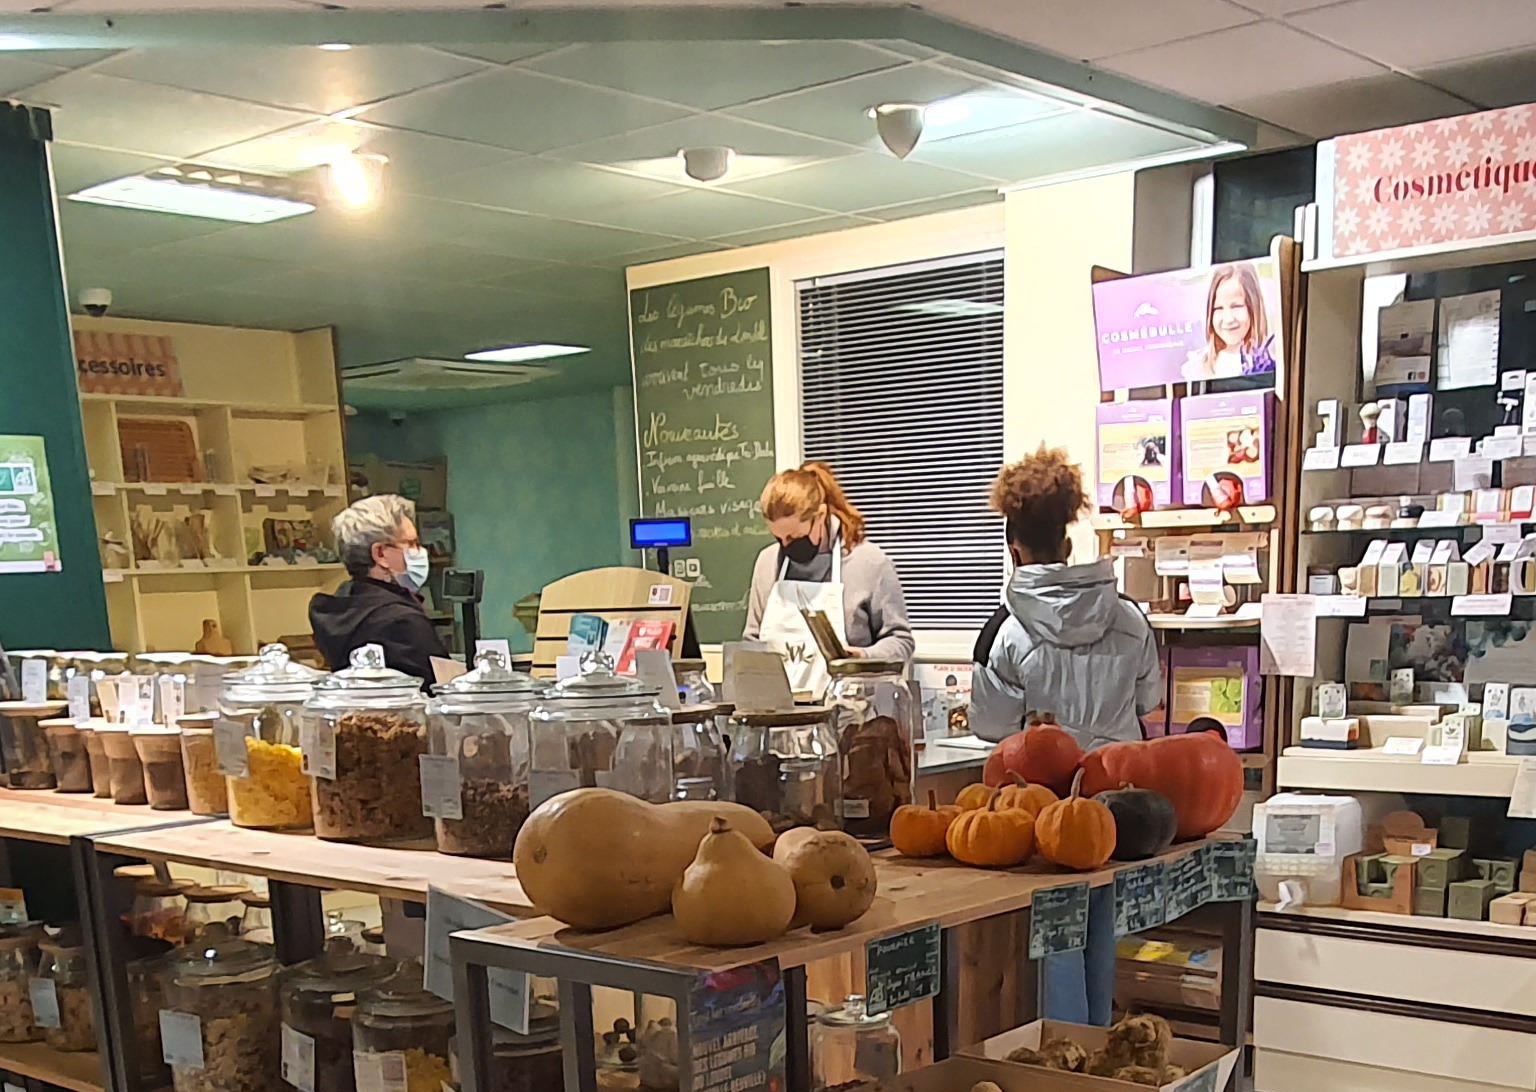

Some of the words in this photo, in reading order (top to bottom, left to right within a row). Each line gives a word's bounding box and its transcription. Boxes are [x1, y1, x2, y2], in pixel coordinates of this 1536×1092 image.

[720, 287, 758, 319] Bio
[692, 1036, 721, 1059] NOUVEL
[723, 1025, 758, 1049] ARRIVAGE
